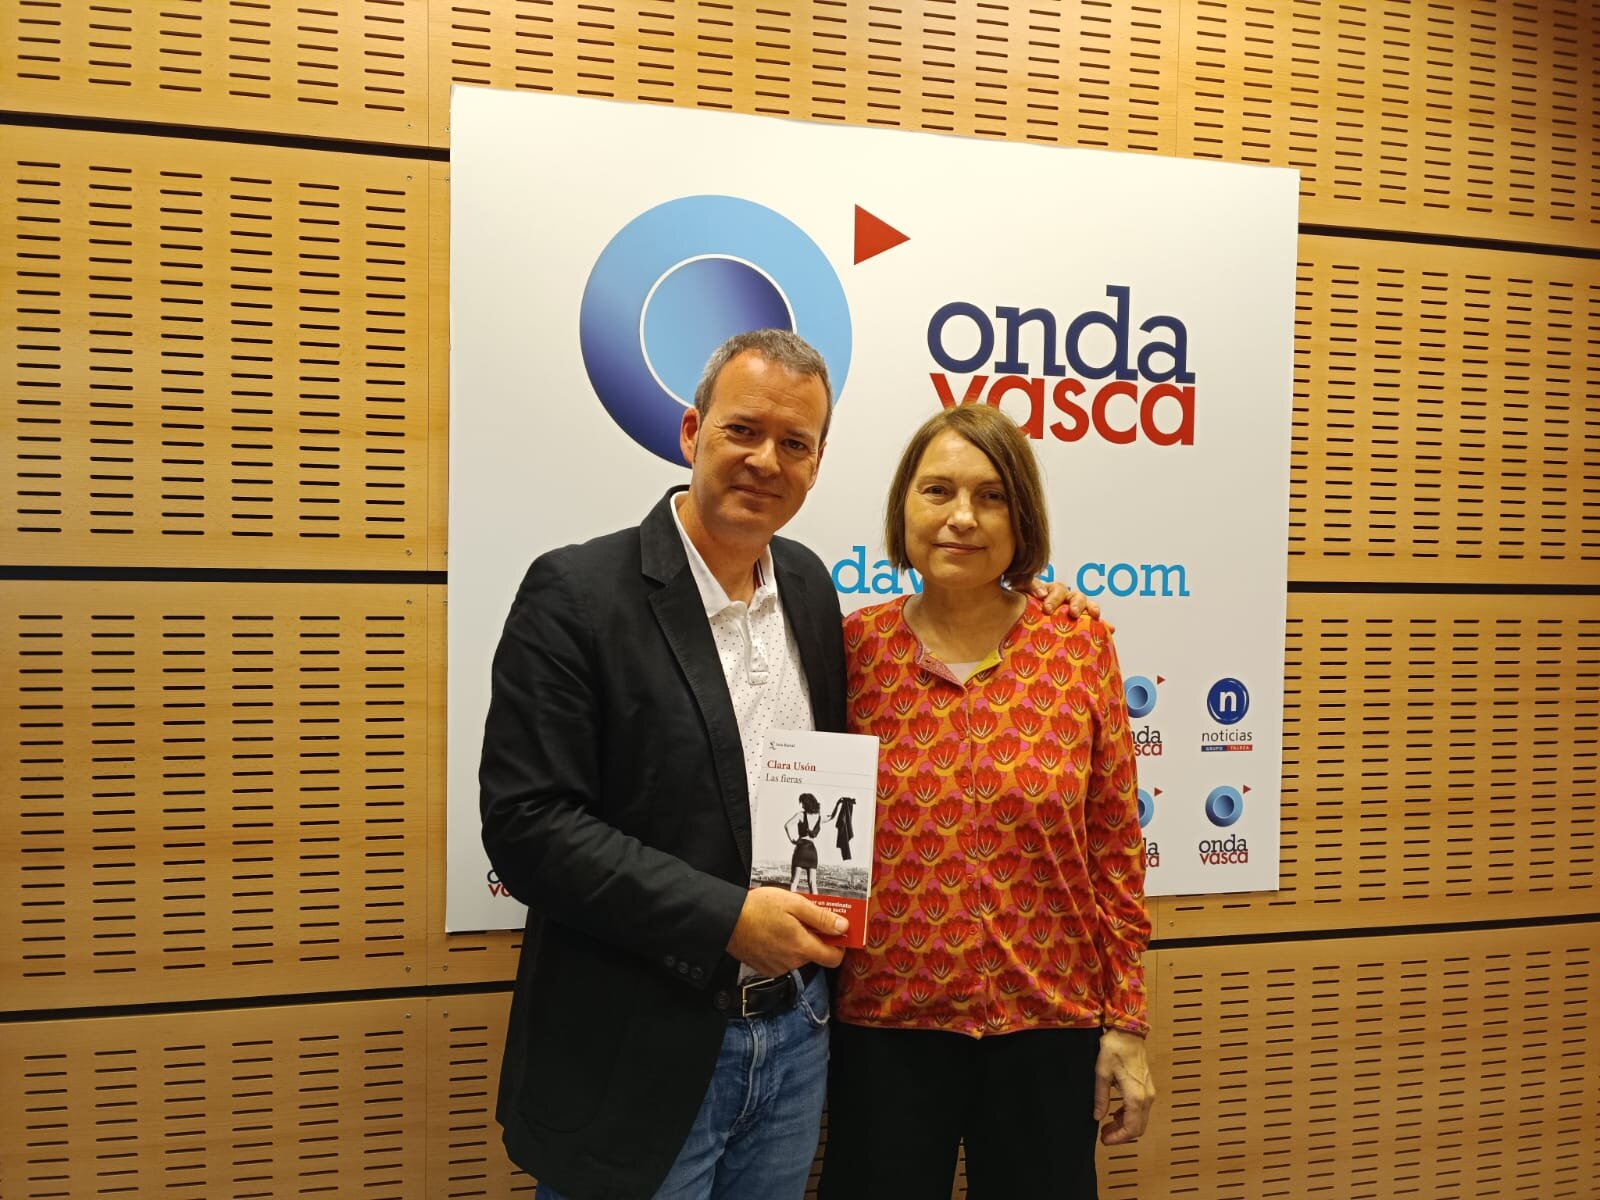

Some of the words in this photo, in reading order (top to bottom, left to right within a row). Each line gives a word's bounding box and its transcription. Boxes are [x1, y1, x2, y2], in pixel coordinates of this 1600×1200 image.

[928, 285, 1195, 384] onda
[930, 372, 1195, 446] vasca
[1219, 691, 1237, 712] n
[1202, 729, 1253, 742] noticias
[1134, 743, 1162, 756] sca
[767, 760, 791, 770] Clara
[793, 761, 816, 772] Usón
[766, 773, 779, 782] Las
[780, 774, 802, 784] fieras
[1199, 834, 1248, 853] onda
[1199, 851, 1248, 866] vasca
